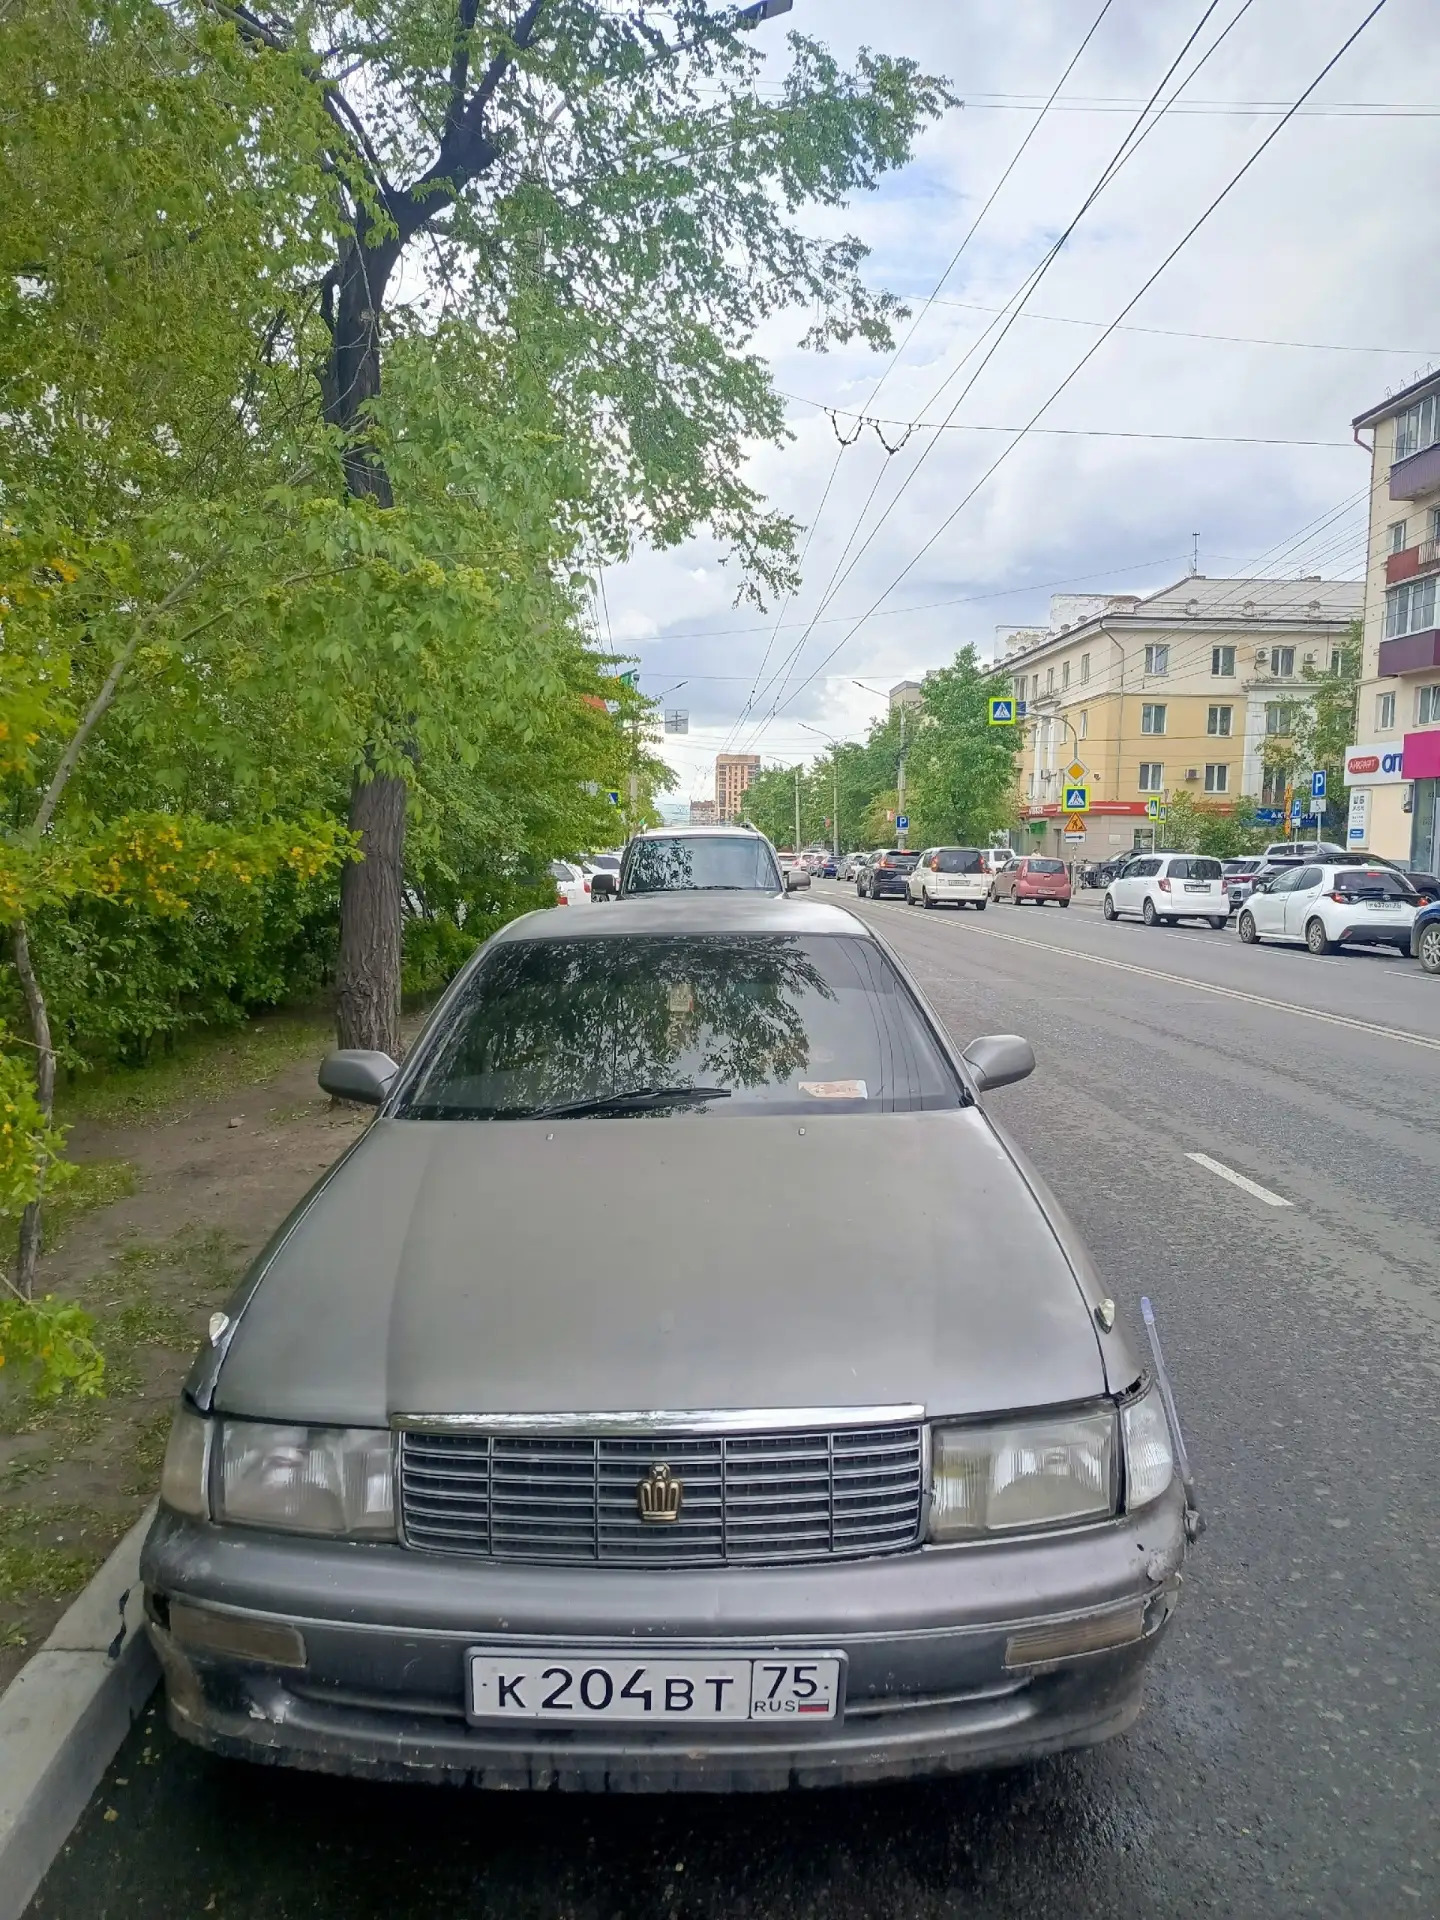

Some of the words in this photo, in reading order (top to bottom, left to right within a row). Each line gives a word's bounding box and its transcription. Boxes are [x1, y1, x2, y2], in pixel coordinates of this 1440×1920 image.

[1382, 754, 1402, 772] ОП
[1315, 773, 1324, 794] P
[498, 1667, 734, 1711] К204ВТ
[763, 1666, 818, 1698] 75
[754, 1700, 796, 1712] RUS
